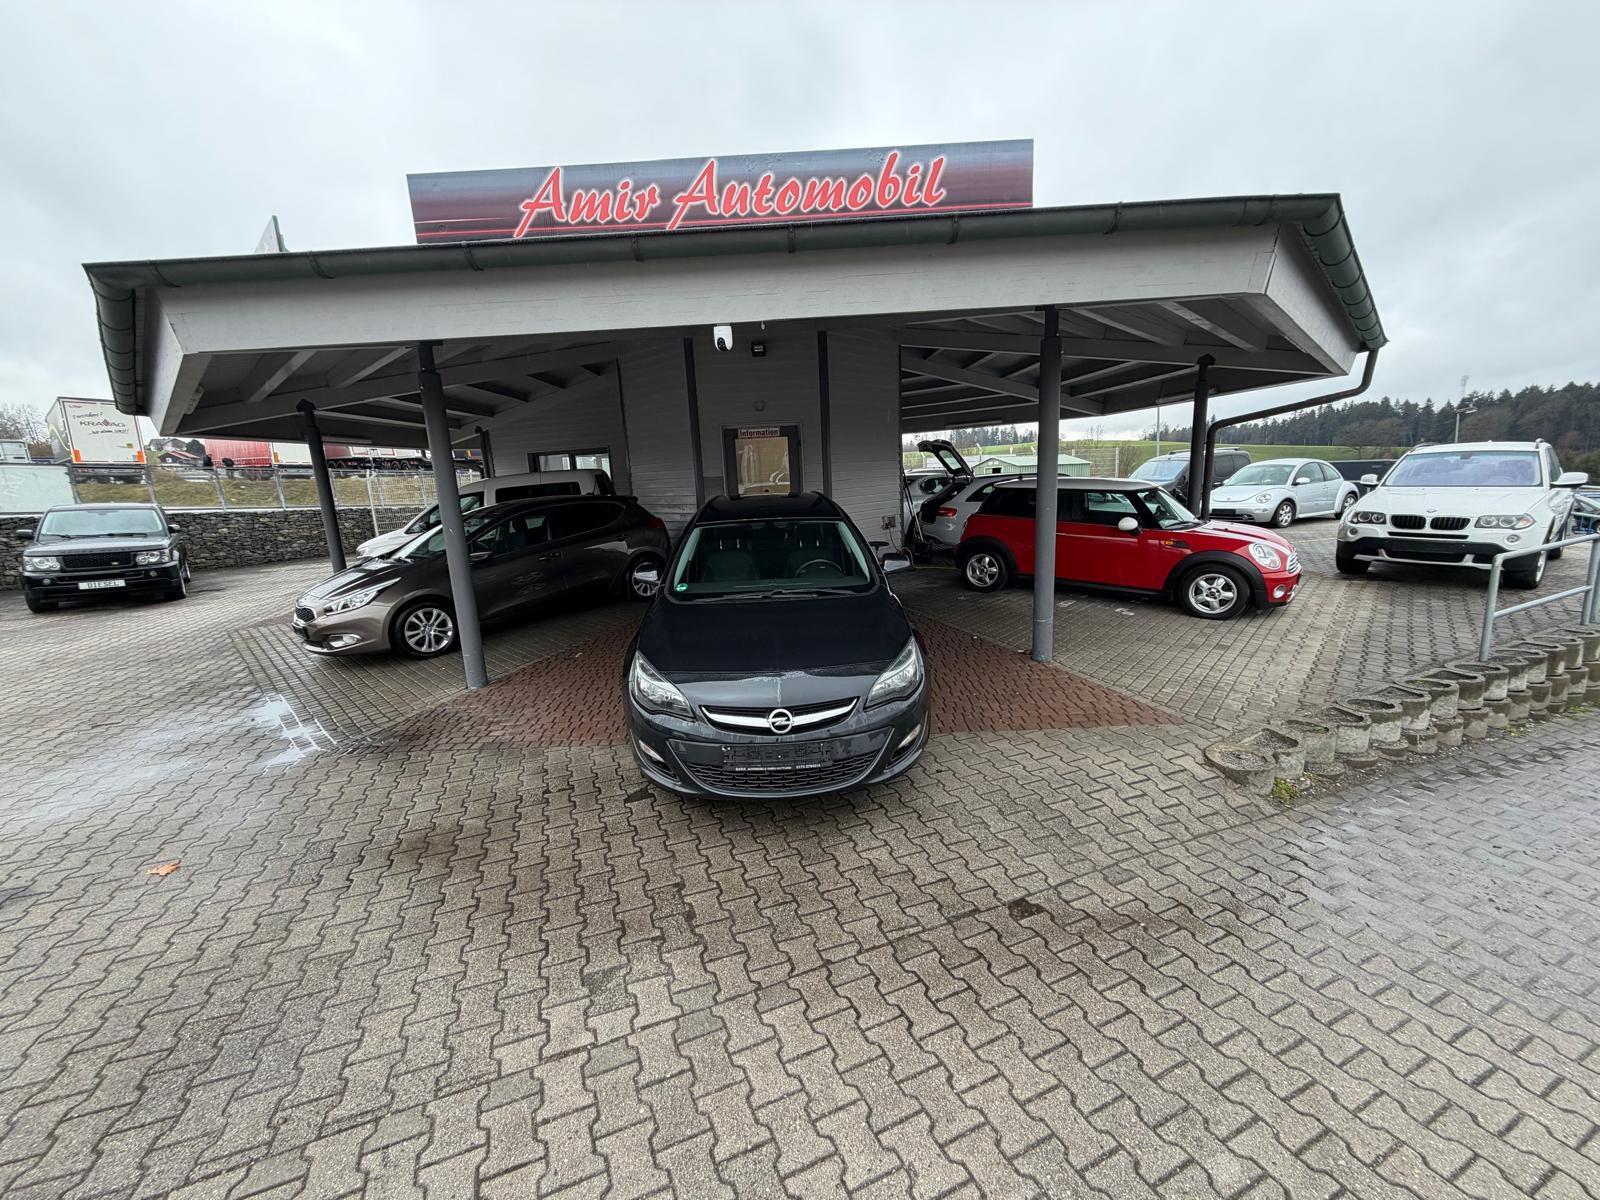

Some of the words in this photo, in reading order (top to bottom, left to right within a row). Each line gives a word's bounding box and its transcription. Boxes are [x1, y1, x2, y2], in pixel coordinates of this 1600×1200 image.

[513, 166, 660, 238] Amir
[666, 151, 947, 230] Automobil
[739, 429, 779, 437] Information
[87, 580, 120, 589] DIESEL
